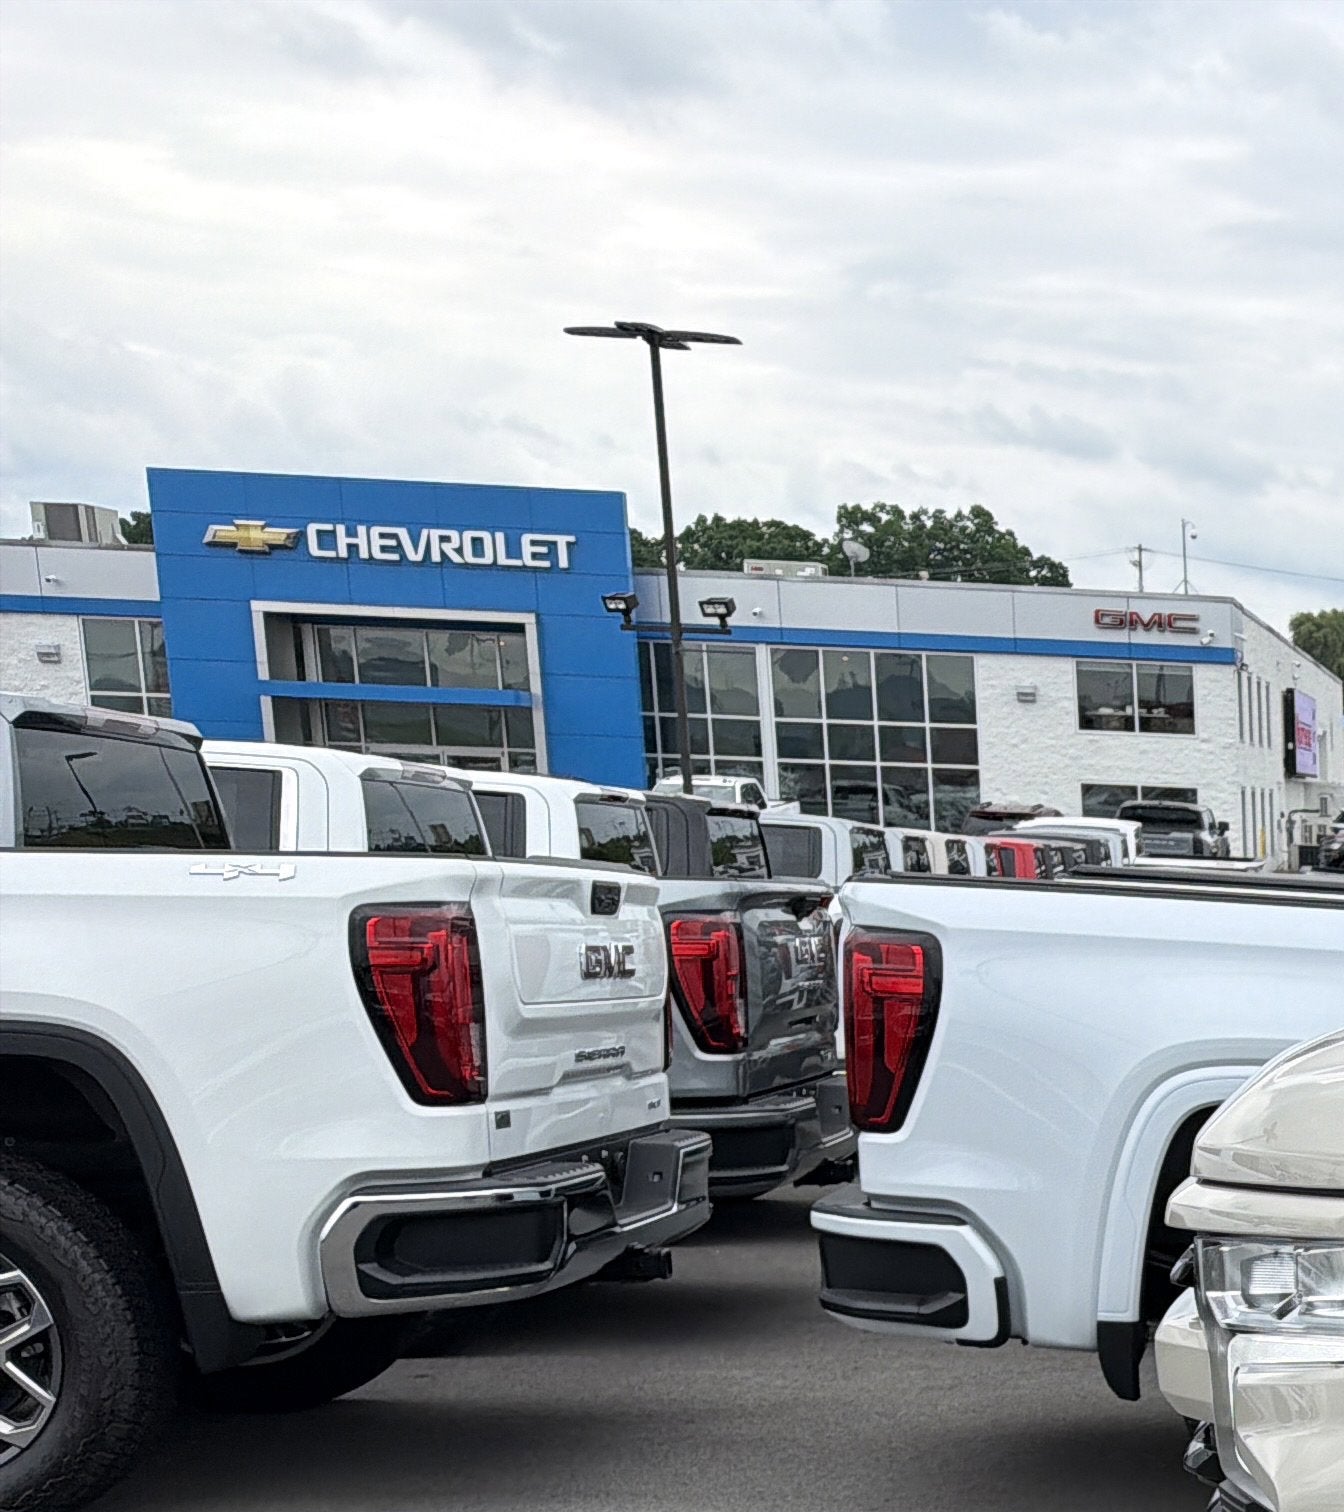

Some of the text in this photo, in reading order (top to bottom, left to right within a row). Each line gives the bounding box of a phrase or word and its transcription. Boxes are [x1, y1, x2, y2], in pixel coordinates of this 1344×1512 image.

[306, 522, 576, 569] CHEVROLET
[1094, 609, 1200, 635] GMC
[580, 943, 636, 980] GMC
[574, 1046, 626, 1063] SIERRA
